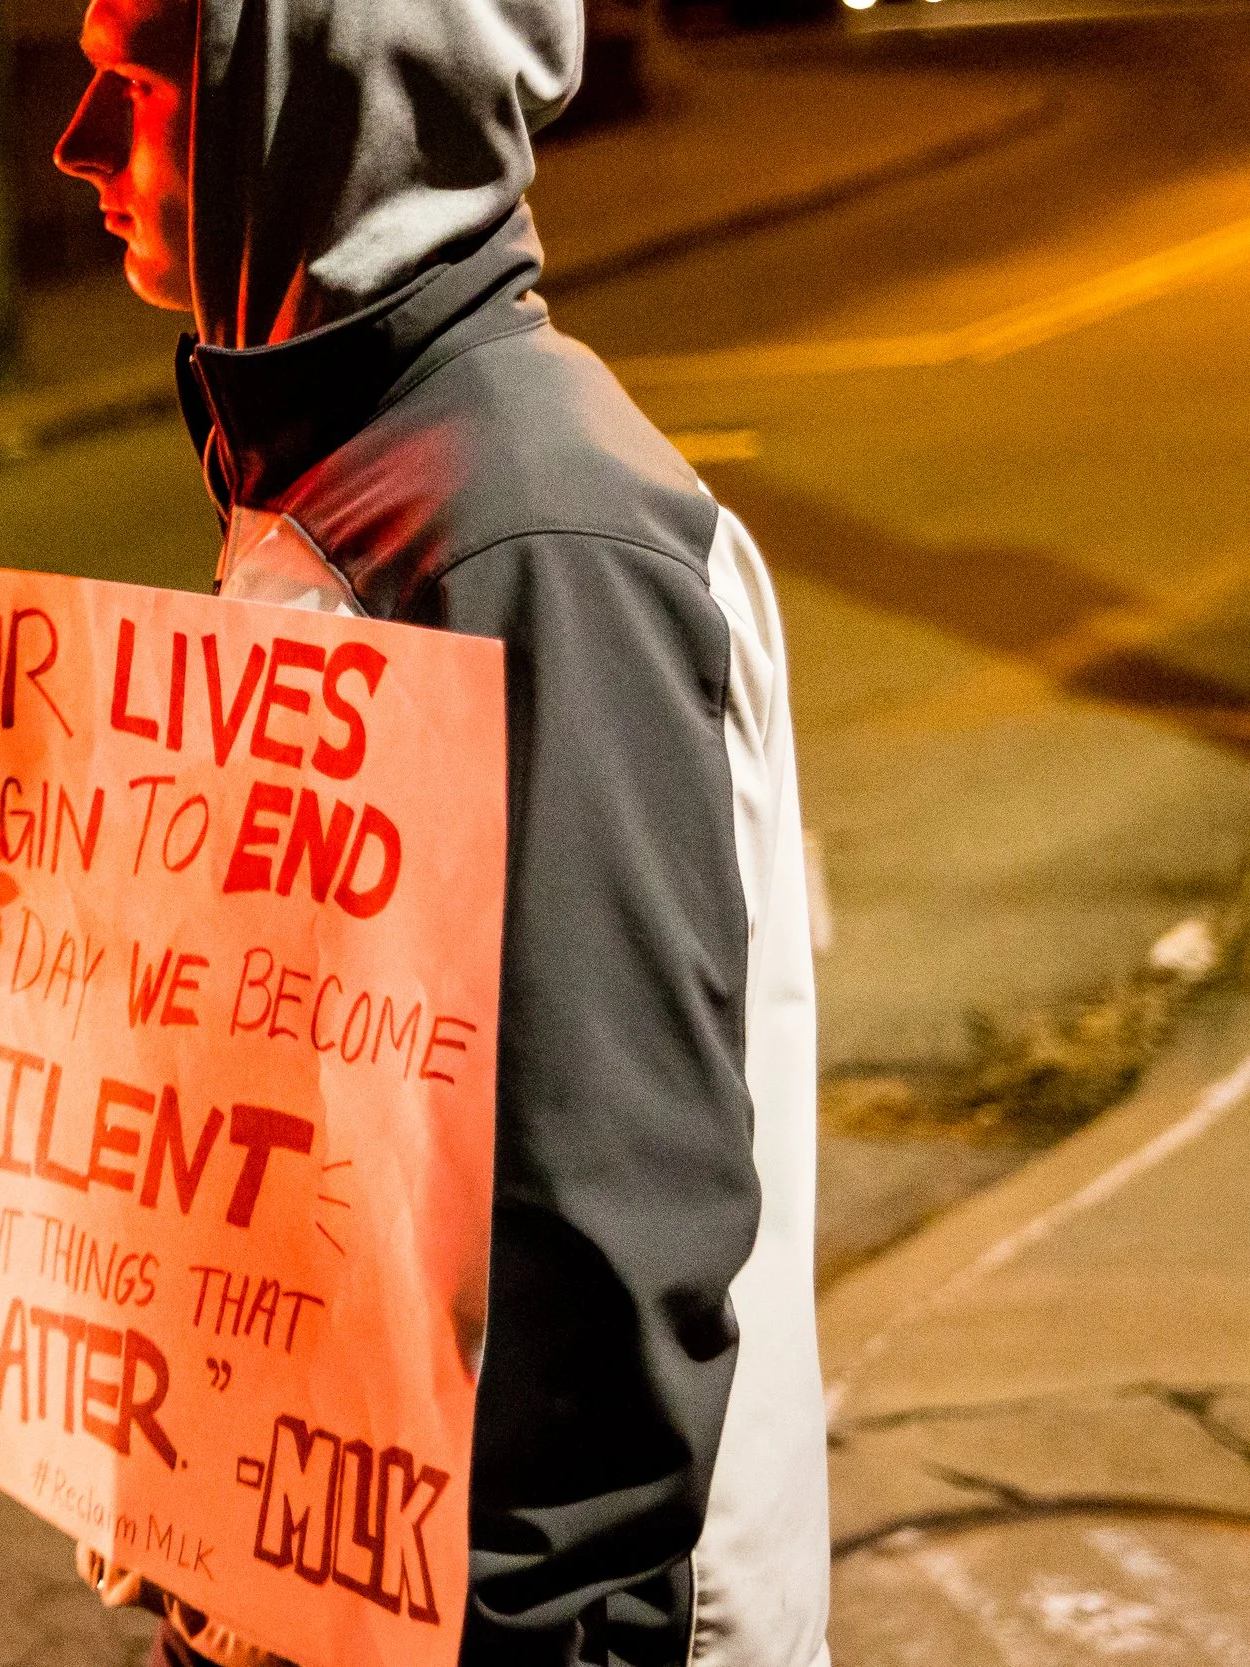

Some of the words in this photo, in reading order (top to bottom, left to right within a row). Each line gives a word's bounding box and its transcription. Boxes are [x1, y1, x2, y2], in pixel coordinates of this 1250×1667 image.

[110, 618, 388, 781] LIVES
[129, 774, 210, 876] TO
[222, 781, 403, 920] END
[10, 905, 106, 1040] DAY
[129, 941, 211, 1029] WE
[230, 947, 478, 1084] BECOME
[31, 1211, 160, 1307] THINGS
[188, 1264, 325, 1354] THAT
